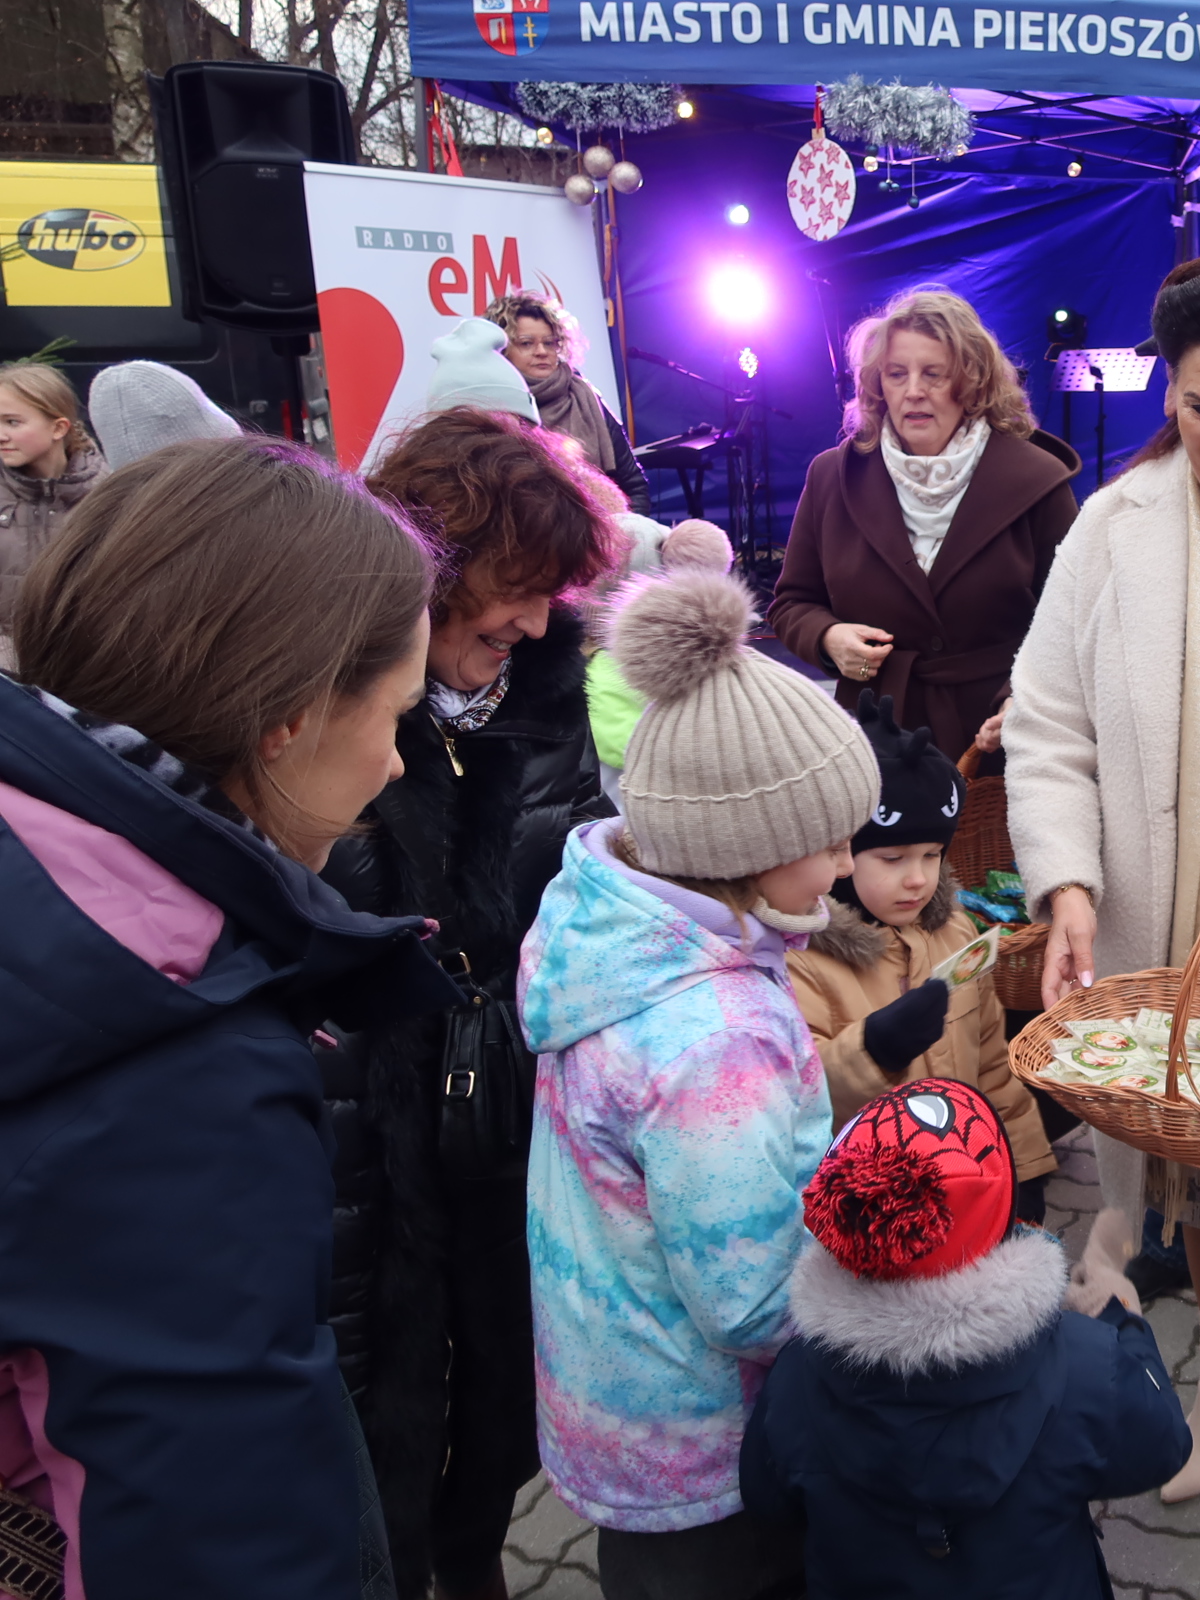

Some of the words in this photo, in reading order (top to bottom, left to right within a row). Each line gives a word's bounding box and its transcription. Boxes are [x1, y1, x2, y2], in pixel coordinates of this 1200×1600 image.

[580, 2, 762, 43] MIASTO
[777, 3, 789, 43] I
[803, 3, 961, 48] GMINA
[27, 219, 136, 251] hubo
[362, 229, 448, 251] RADIO
[428, 234, 523, 317] eM
